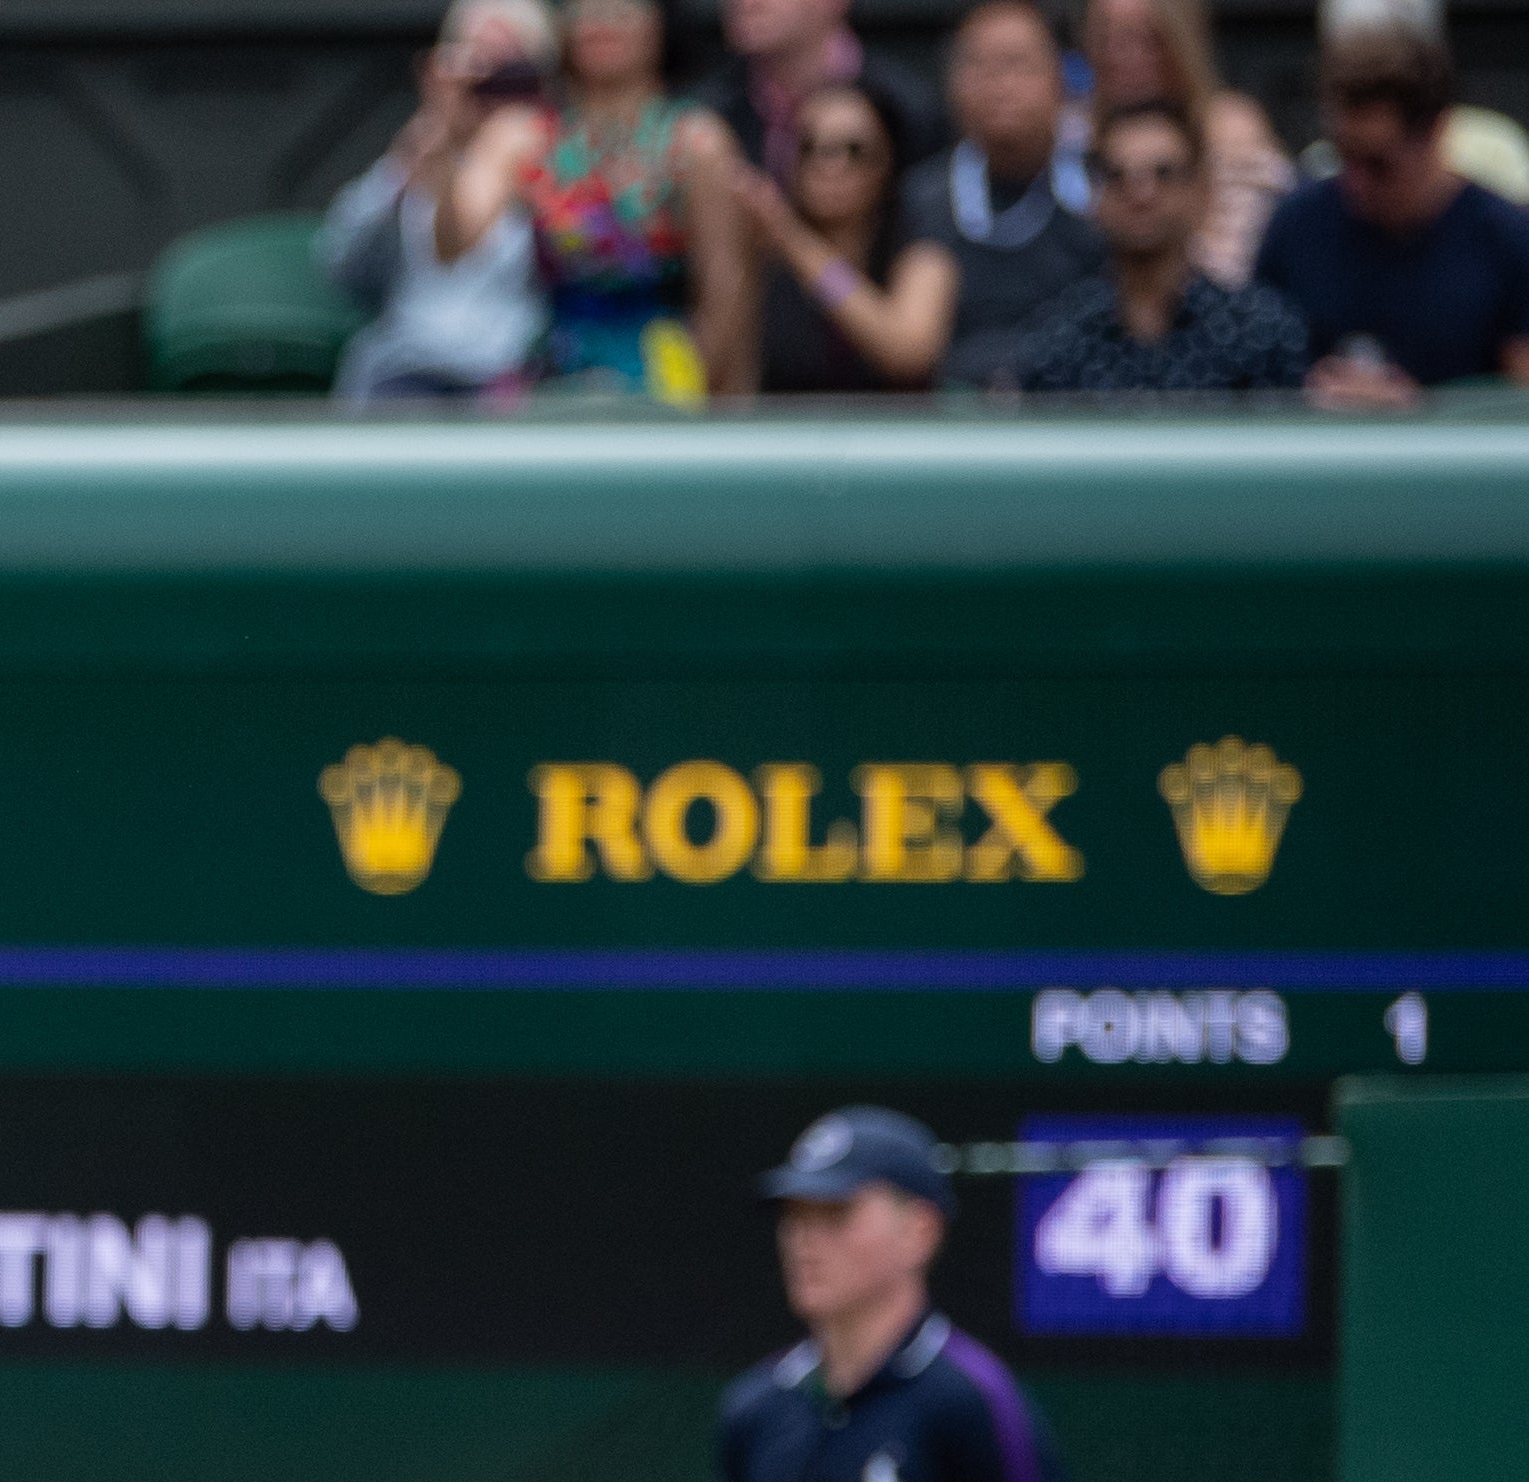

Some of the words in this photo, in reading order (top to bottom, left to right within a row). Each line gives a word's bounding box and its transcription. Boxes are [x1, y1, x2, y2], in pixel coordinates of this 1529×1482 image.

[528, 760, 1082, 885] ROLEX
[1031, 988, 1290, 1065] POINTS
[1035, 1154, 1279, 1298] 40
[226, 1238, 360, 1331] ITA
